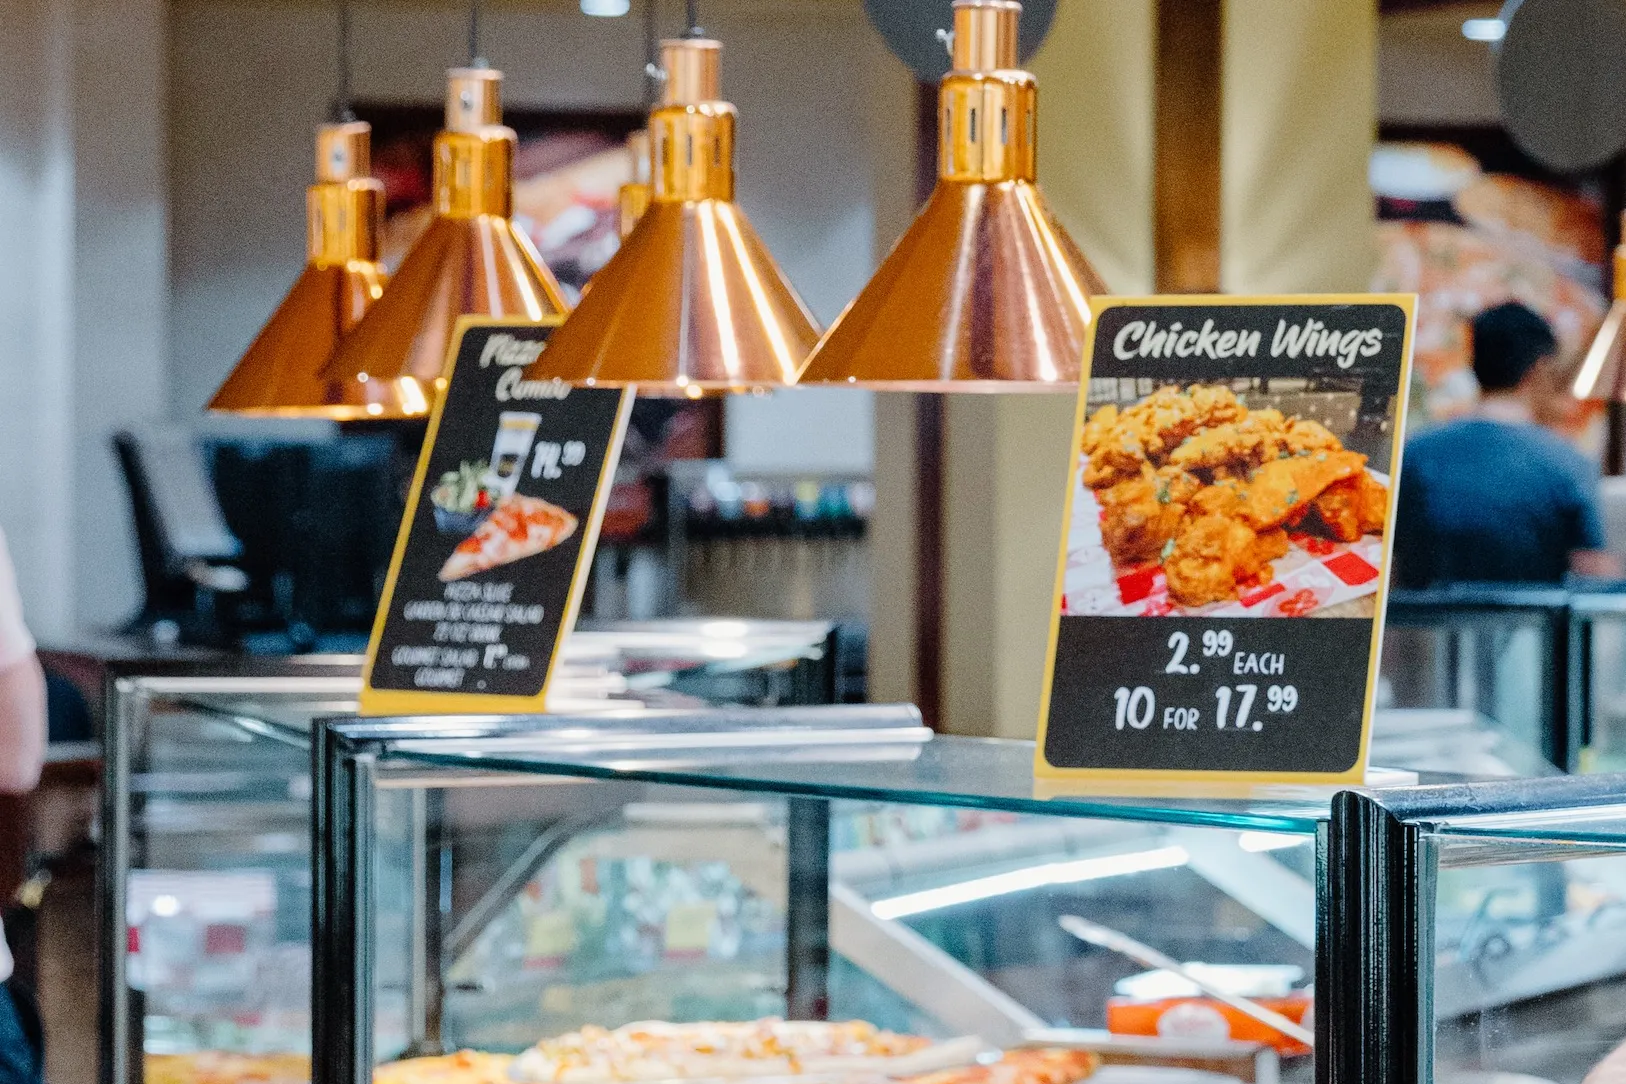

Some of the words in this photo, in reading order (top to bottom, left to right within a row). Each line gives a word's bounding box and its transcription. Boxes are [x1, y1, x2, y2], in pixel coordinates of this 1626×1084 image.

[1112, 318, 1261, 361] Chicken
[1270, 317, 1382, 369] Wings
[1234, 651, 1285, 676] EACH
[1113, 685, 1155, 731] 10
[1163, 707, 1199, 731] FOR
